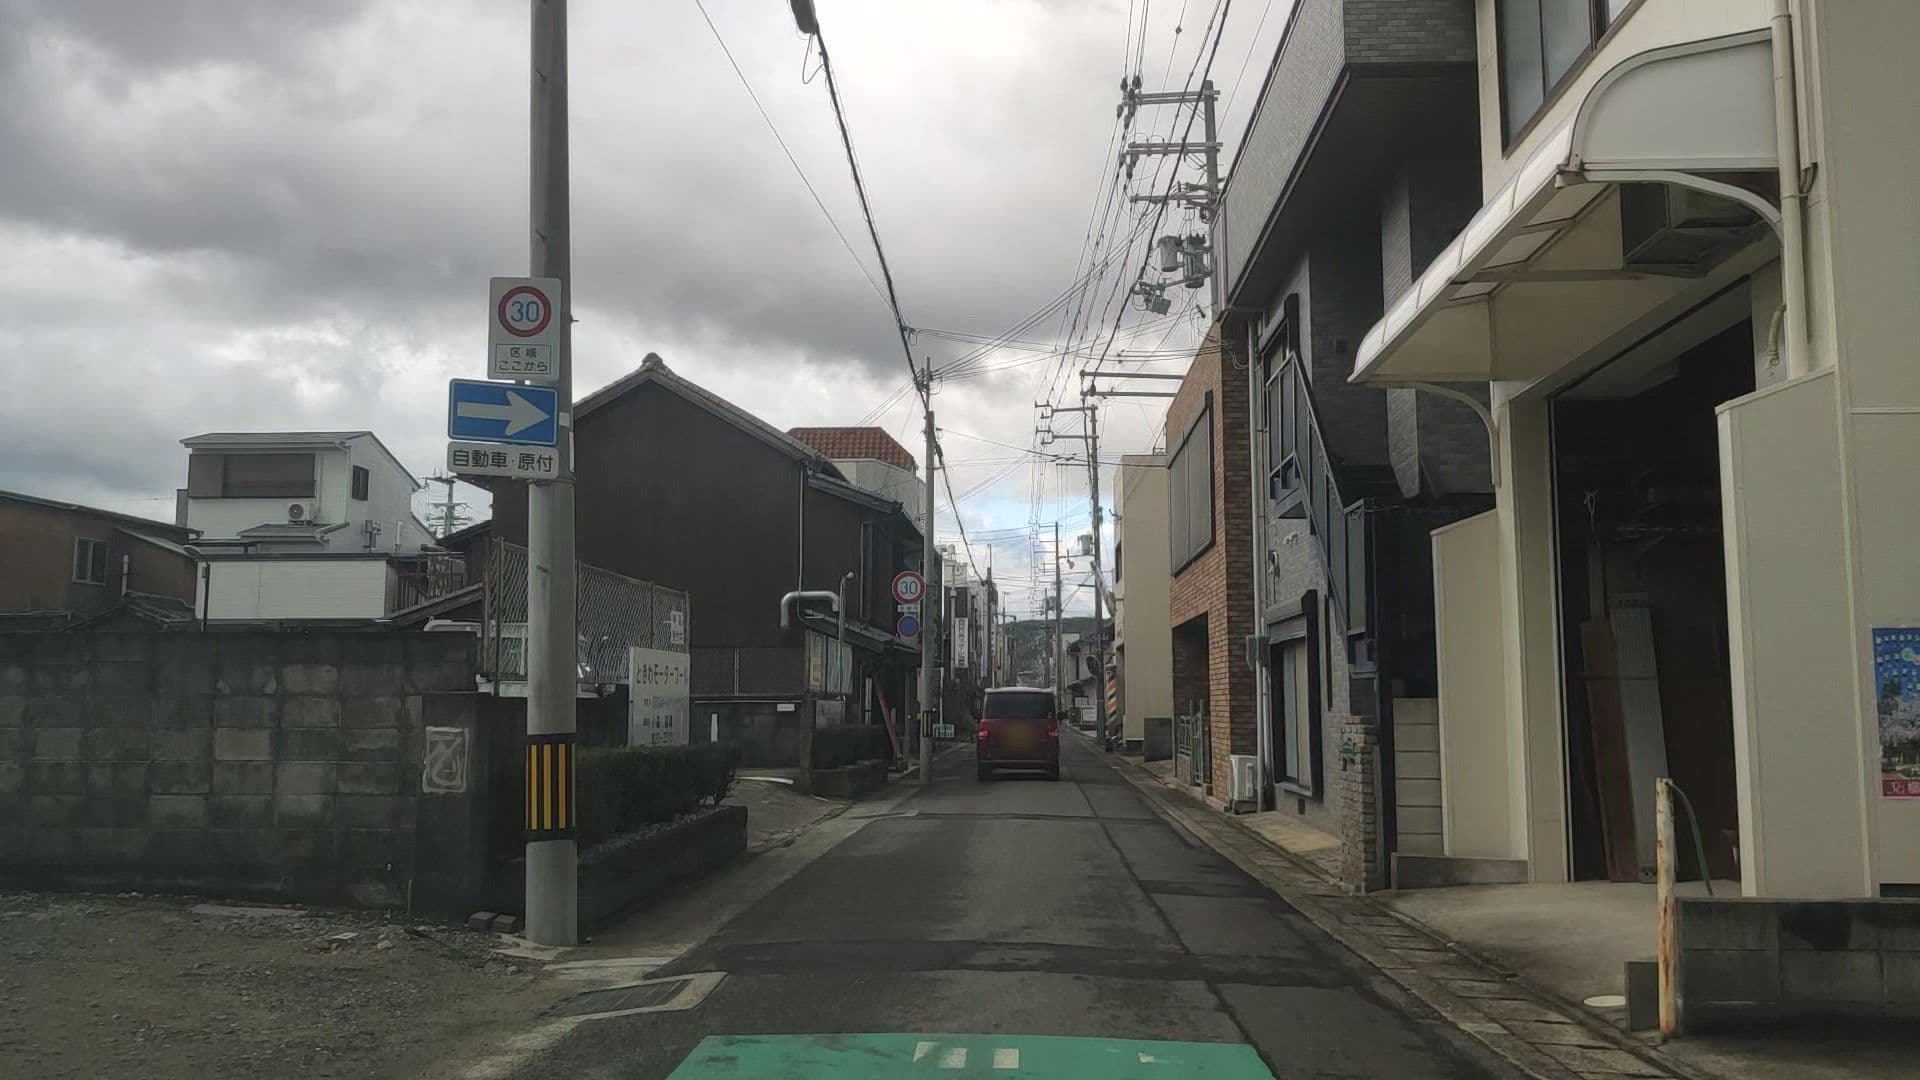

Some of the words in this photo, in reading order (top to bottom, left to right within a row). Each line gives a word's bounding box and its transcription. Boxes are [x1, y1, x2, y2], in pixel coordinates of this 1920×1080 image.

[510, 300, 540, 323] 30
[510, 347, 537, 358] 区域
[499, 360, 548, 372] ここから
[900, 581, 918, 595] 30
